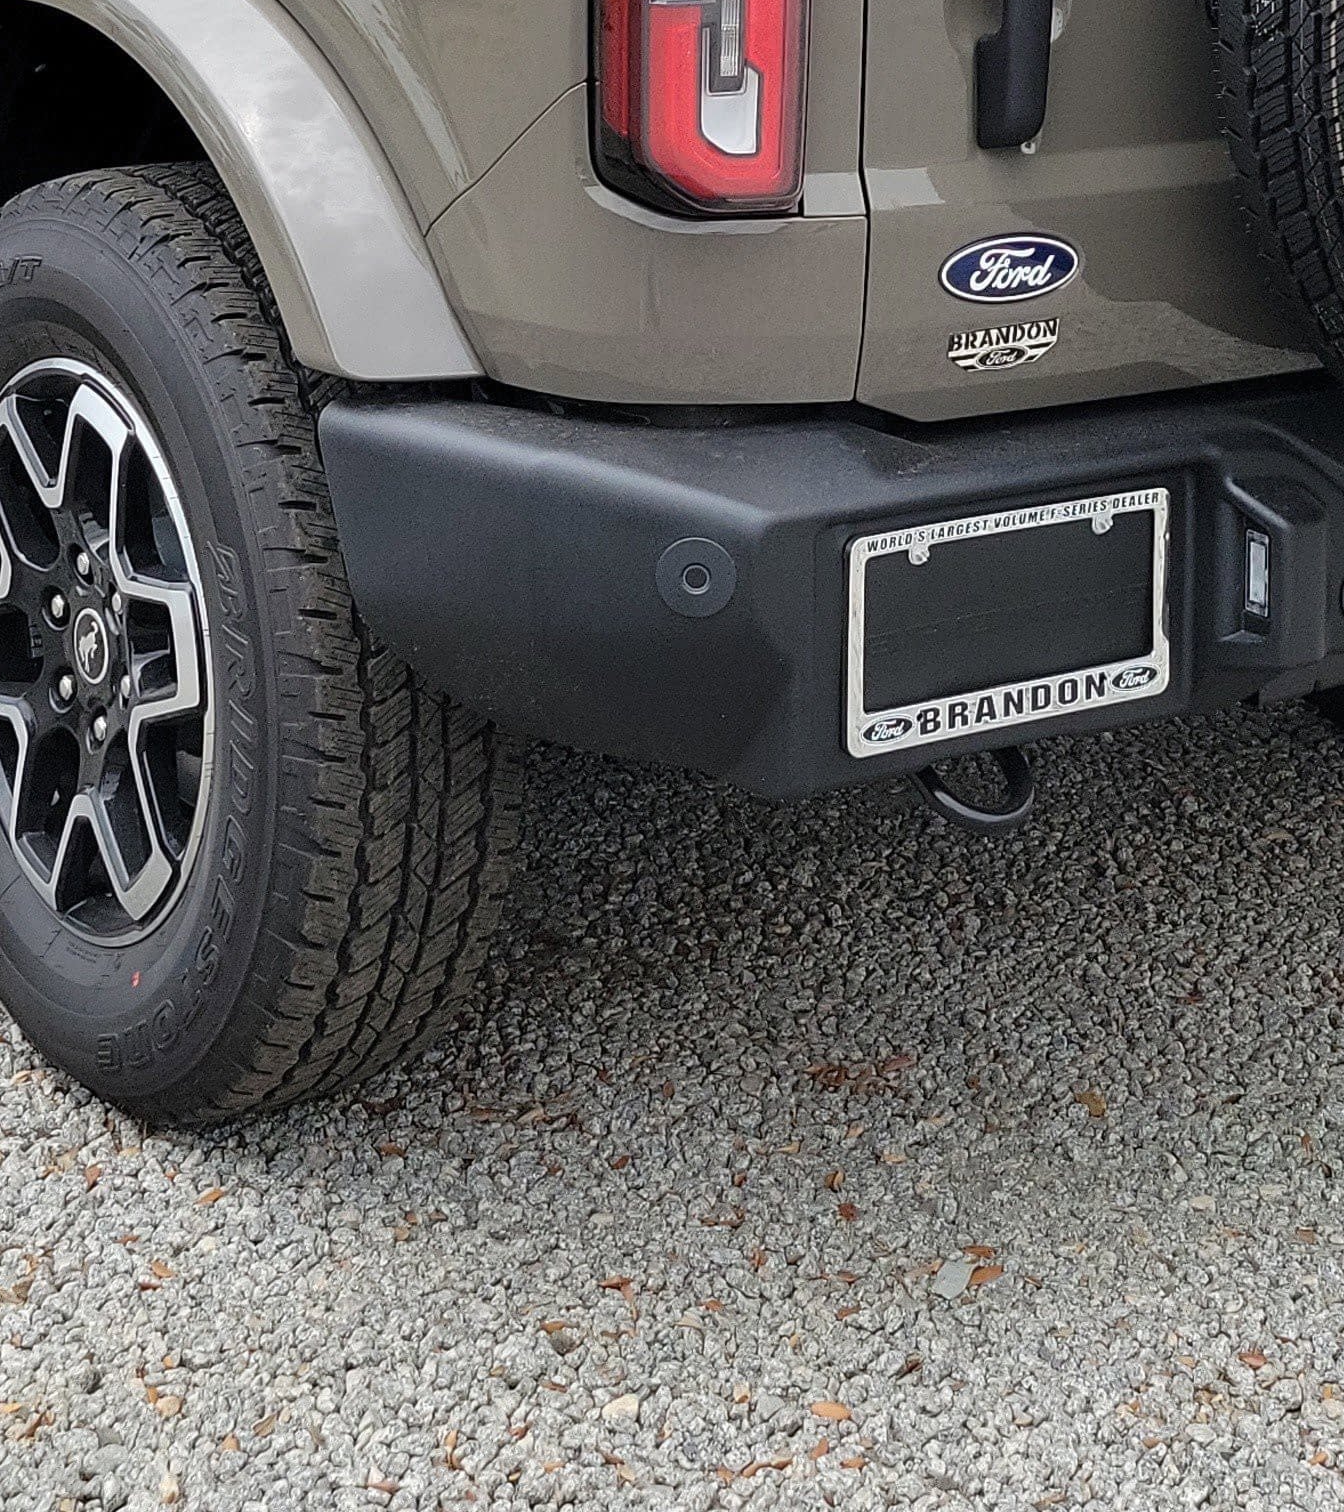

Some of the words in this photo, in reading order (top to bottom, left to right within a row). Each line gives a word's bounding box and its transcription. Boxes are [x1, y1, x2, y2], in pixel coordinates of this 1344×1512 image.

[969, 247, 1056, 291] Ford
[948, 316, 1059, 352] BRANDON
[985, 349, 1018, 366] Ford
[867, 529, 926, 553] WORLD'S
[930, 519, 989, 540] LARGEST
[994, 510, 1045, 529] VOLUME
[1050, 499, 1107, 519] F-SERIES
[1112, 492, 1160, 510] DEALER
[871, 720, 905, 740] Ford
[919, 670, 1108, 736] BRANDON
[1118, 667, 1151, 689] Ford
